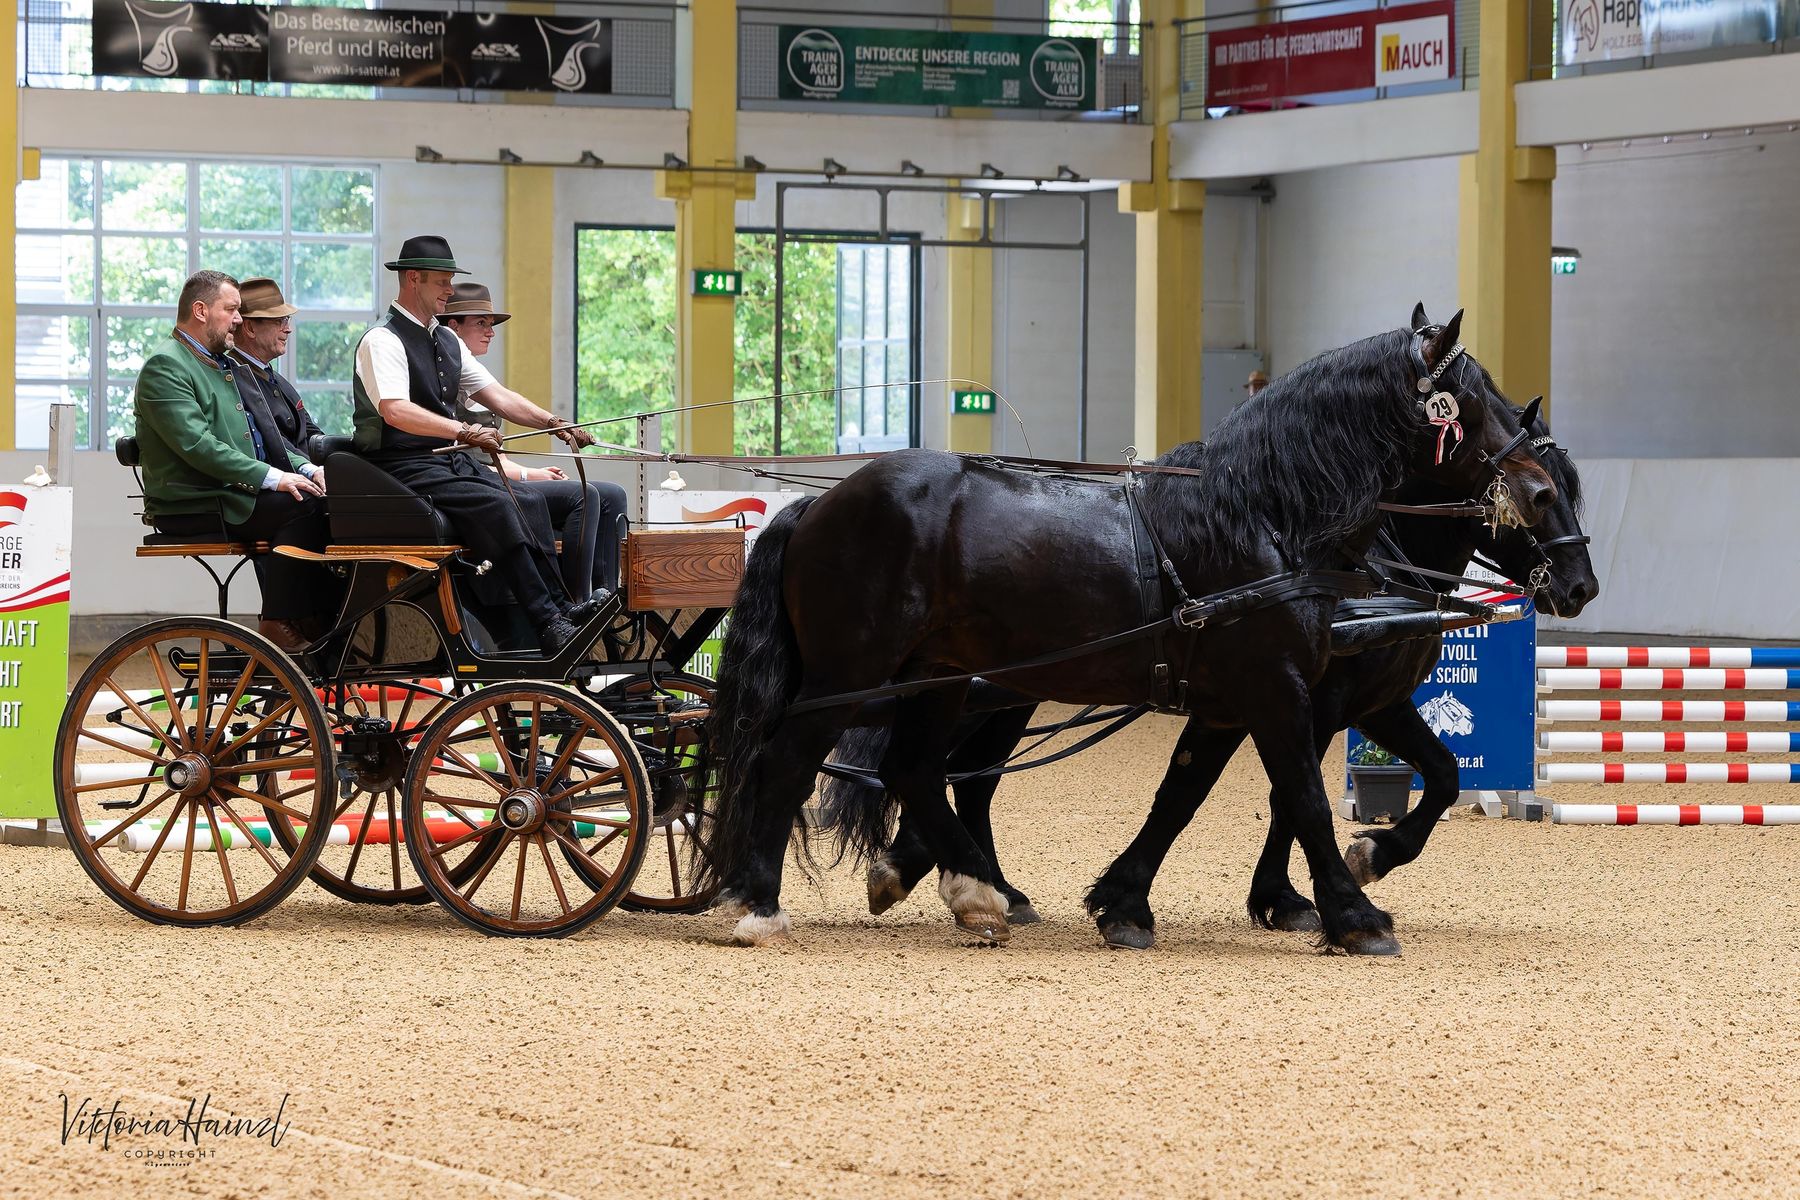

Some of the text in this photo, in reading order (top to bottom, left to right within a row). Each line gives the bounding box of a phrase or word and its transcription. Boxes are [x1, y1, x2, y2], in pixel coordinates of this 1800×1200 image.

[274, 11, 446, 35] Das Beste zwischen
[286, 37, 434, 60] Pferd und Reiter!
[1228, 40, 1260, 65] PARTNER
[1262, 33, 1274, 60] FÜR
[1289, 25, 1363, 57] PFERDEWIRTSCHAFT
[801, 51, 838, 63] TRAUN
[855, 46, 1020, 67] ENTDECKE UNSERE REGION
[1386, 40, 1443, 72] MAUCH
[313, 64, 400, 77] www.3s-sattel.at
[810, 63, 838, 75] AGER
[1045, 60, 1079, 73] TRAUN
[815, 75, 838, 86] ALM
[1052, 72, 1079, 83] AGER
[1056, 84, 1079, 95] ALM
[1431, 398, 1453, 418] 29
[1436, 664, 1478, 684] SCHÖN
